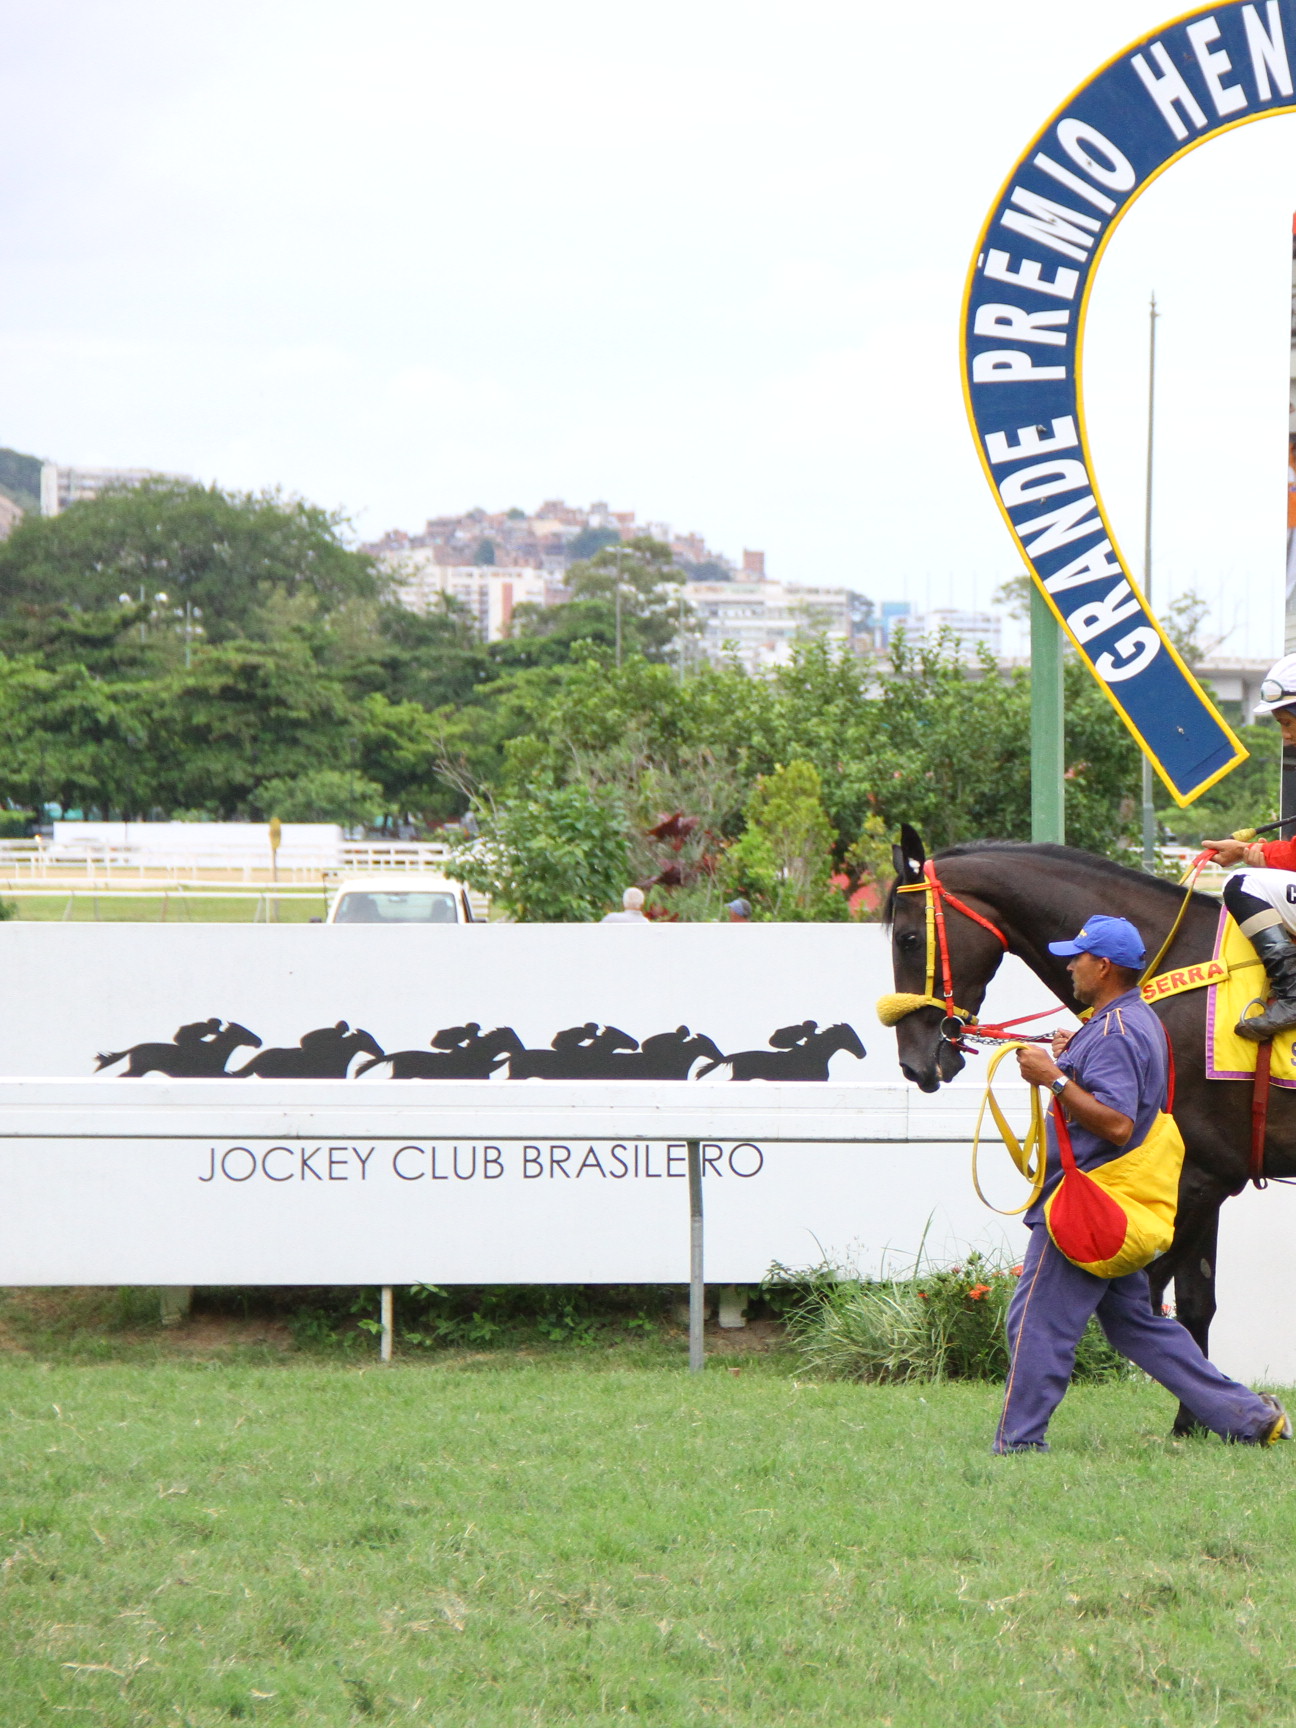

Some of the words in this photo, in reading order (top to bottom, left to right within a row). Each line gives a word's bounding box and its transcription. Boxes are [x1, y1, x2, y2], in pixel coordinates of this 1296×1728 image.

[985, 415, 1161, 682] GRANDE
[1142, 963, 1225, 1000] SERRA
[198, 1147, 375, 1182] JOCKEY
[391, 1145, 505, 1181] CLUB
[522, 1142, 764, 1180] BRASILERO
